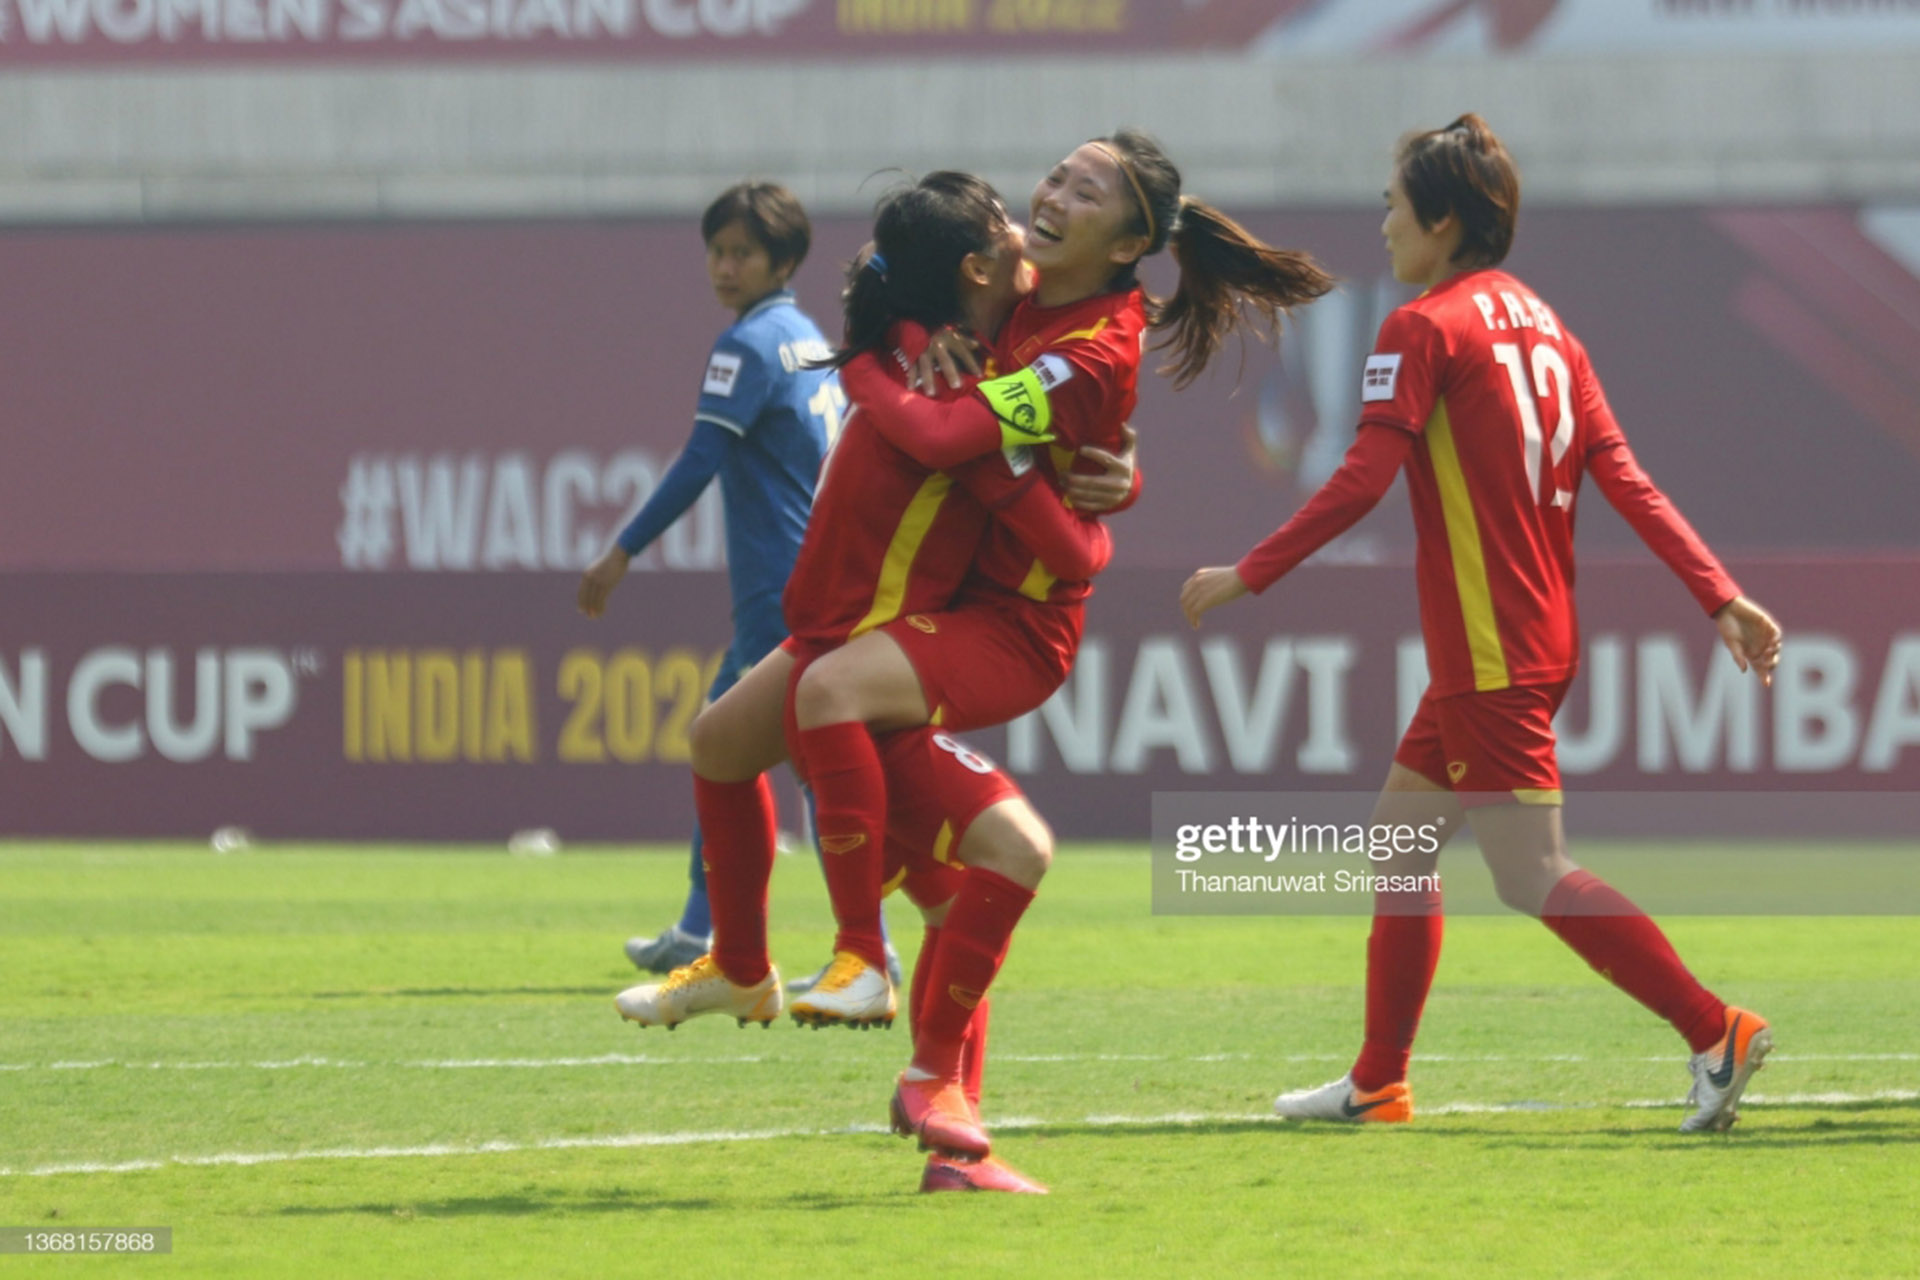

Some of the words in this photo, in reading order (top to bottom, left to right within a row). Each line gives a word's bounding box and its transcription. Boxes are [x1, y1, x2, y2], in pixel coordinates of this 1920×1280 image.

[14, 0, 390, 43] WOMENS
[1492, 343, 1574, 512] 12
[66, 646, 298, 764] CUP
[343, 649, 534, 764] INDIA
[556, 648, 728, 764] 202
[932, 733, 994, 774] 8
[1006, 635, 1355, 774] NAVI
